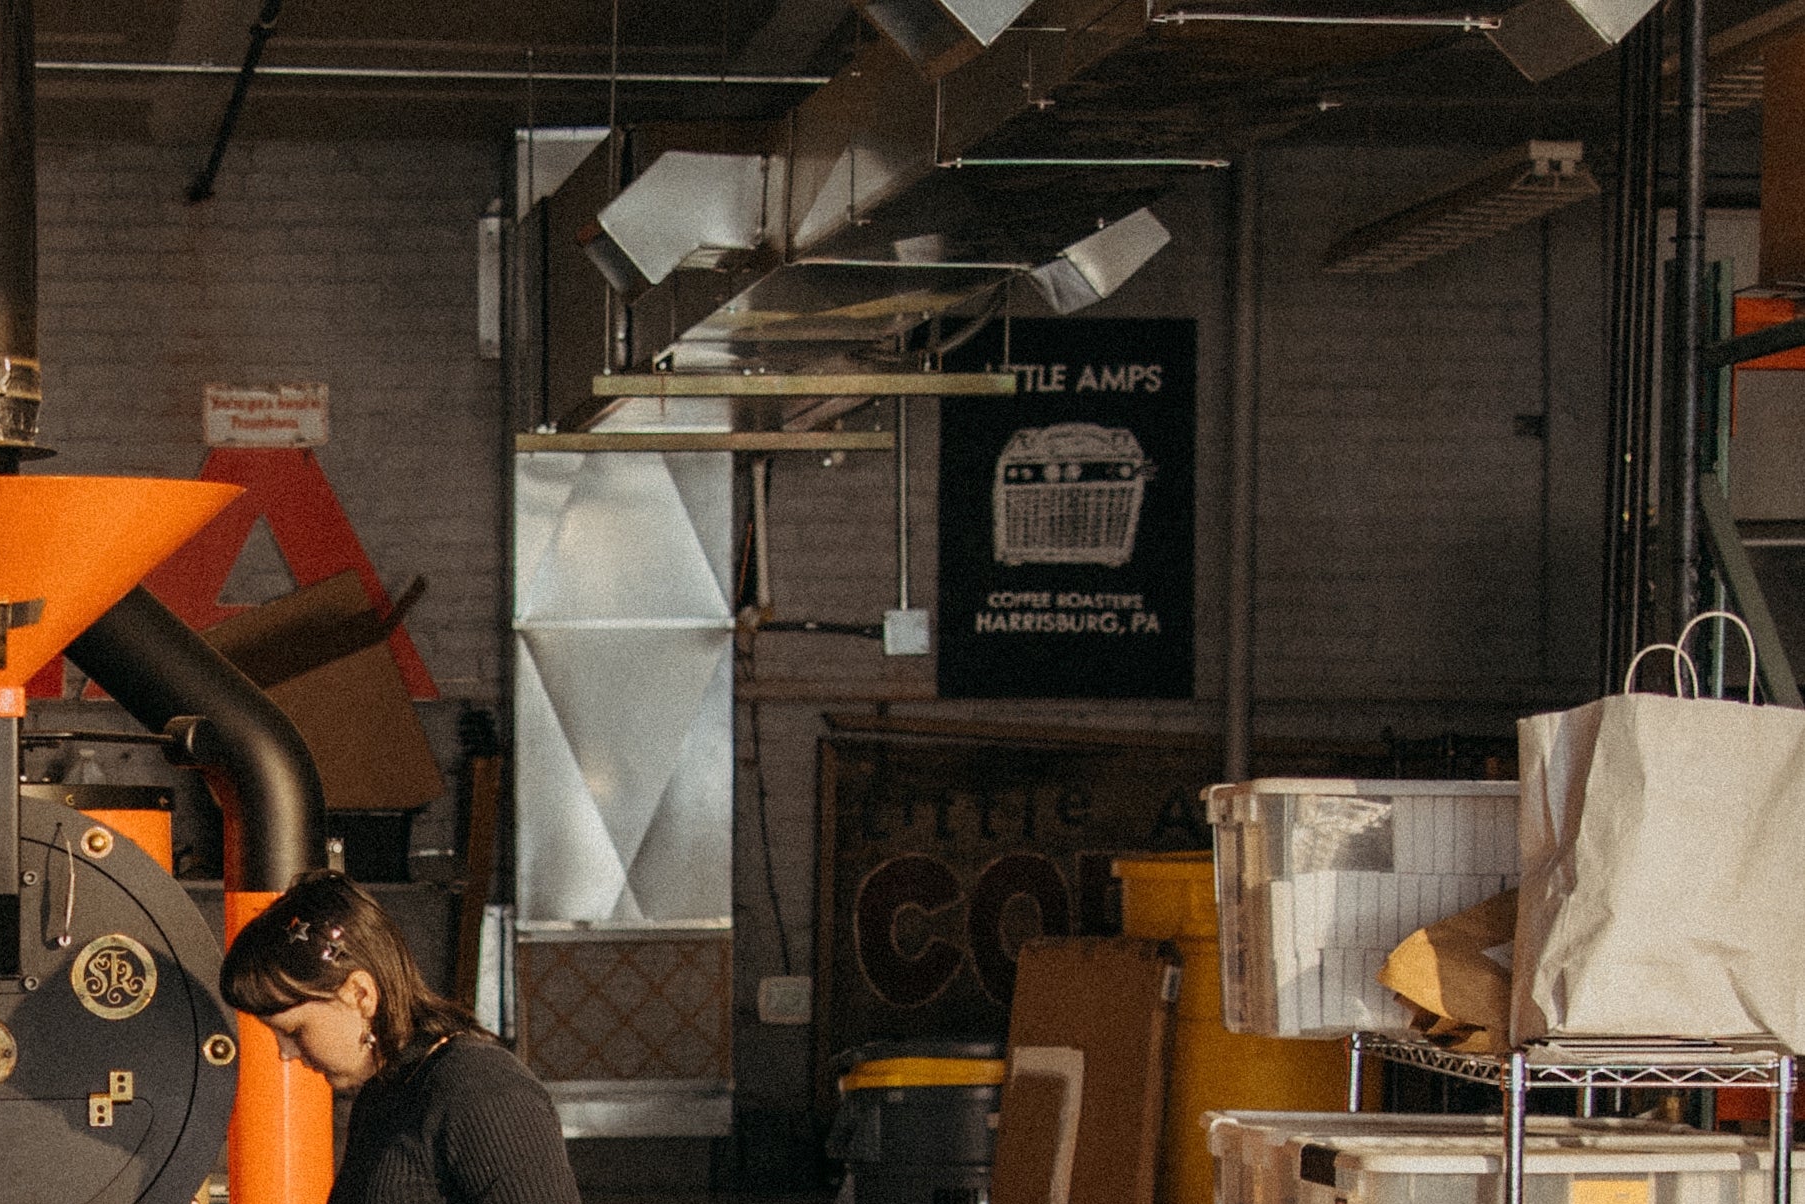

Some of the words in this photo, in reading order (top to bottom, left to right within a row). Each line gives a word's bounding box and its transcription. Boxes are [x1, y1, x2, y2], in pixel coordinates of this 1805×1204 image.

[985, 363, 1068, 393] TLE
[1076, 363, 1162, 394] AMPS
[987, 591, 1051, 609] COFFEE
[1057, 592, 1144, 609] ROASTERS
[975, 611, 1126, 635] HARRISBURG,
[1131, 612, 1161, 635] PA
